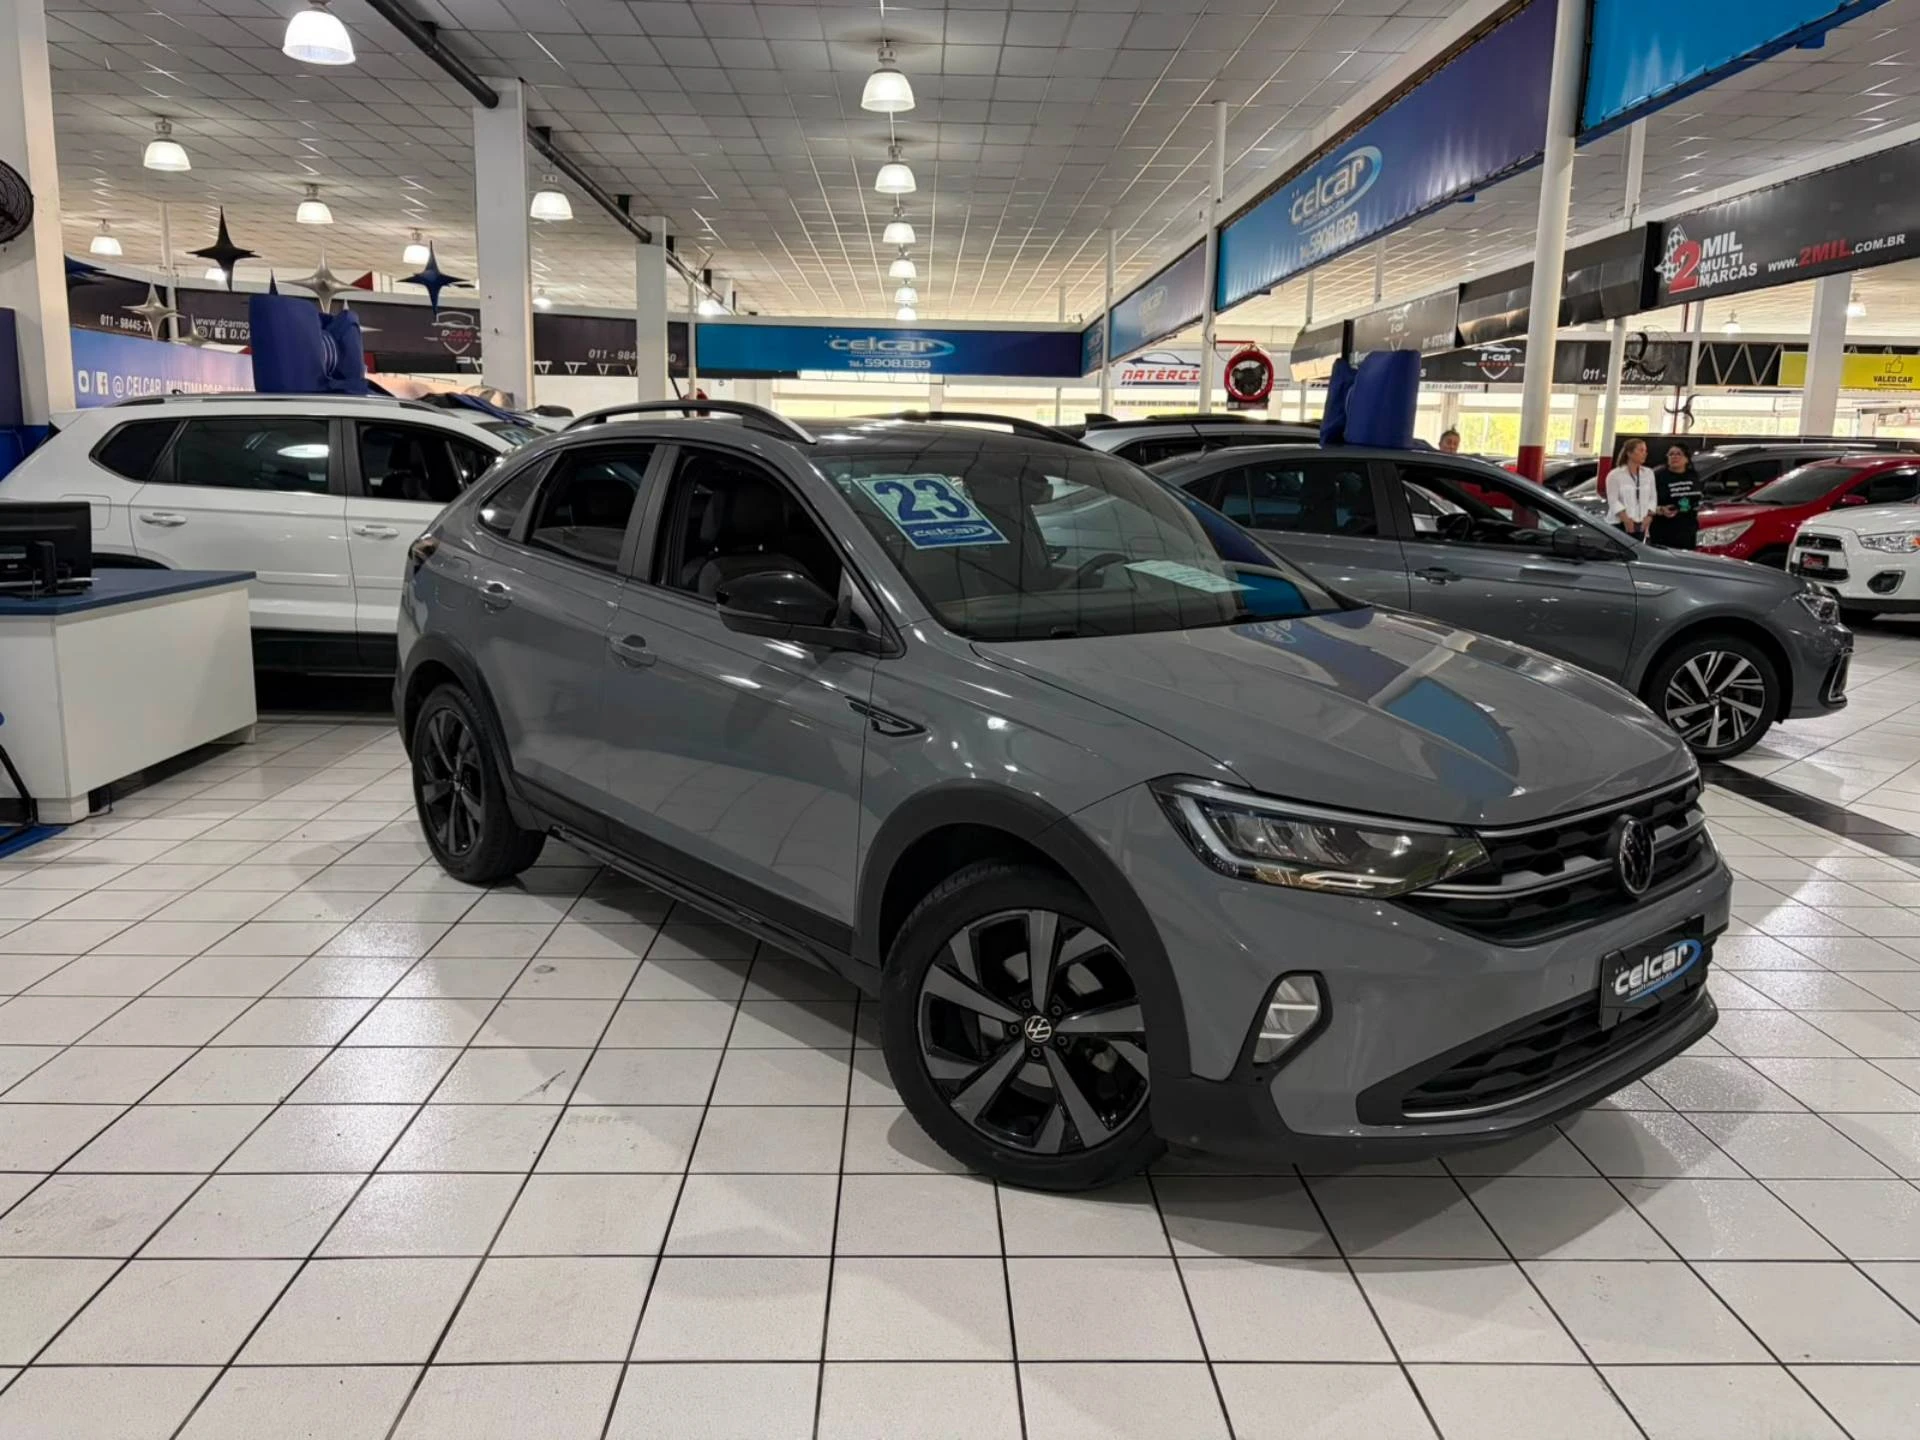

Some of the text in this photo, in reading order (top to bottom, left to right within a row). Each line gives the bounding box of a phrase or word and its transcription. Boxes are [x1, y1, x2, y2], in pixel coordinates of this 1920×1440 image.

[1291, 157, 1366, 225] celcar
[1668, 231, 1743, 294] 2 MIL
[1700, 251, 1744, 274] MULTI
[1699, 262, 1758, 288] MARCAS
[100, 313, 115, 327] 011
[588, 348, 607, 360] 011
[830, 336, 934, 352] celcar
[1583, 368, 1600, 380] 011
[1898, 375, 1914, 384] CAR
[126, 375, 162, 397] CELCAR
[873, 479, 970, 521] 23
[1614, 943, 1688, 995] celcar
